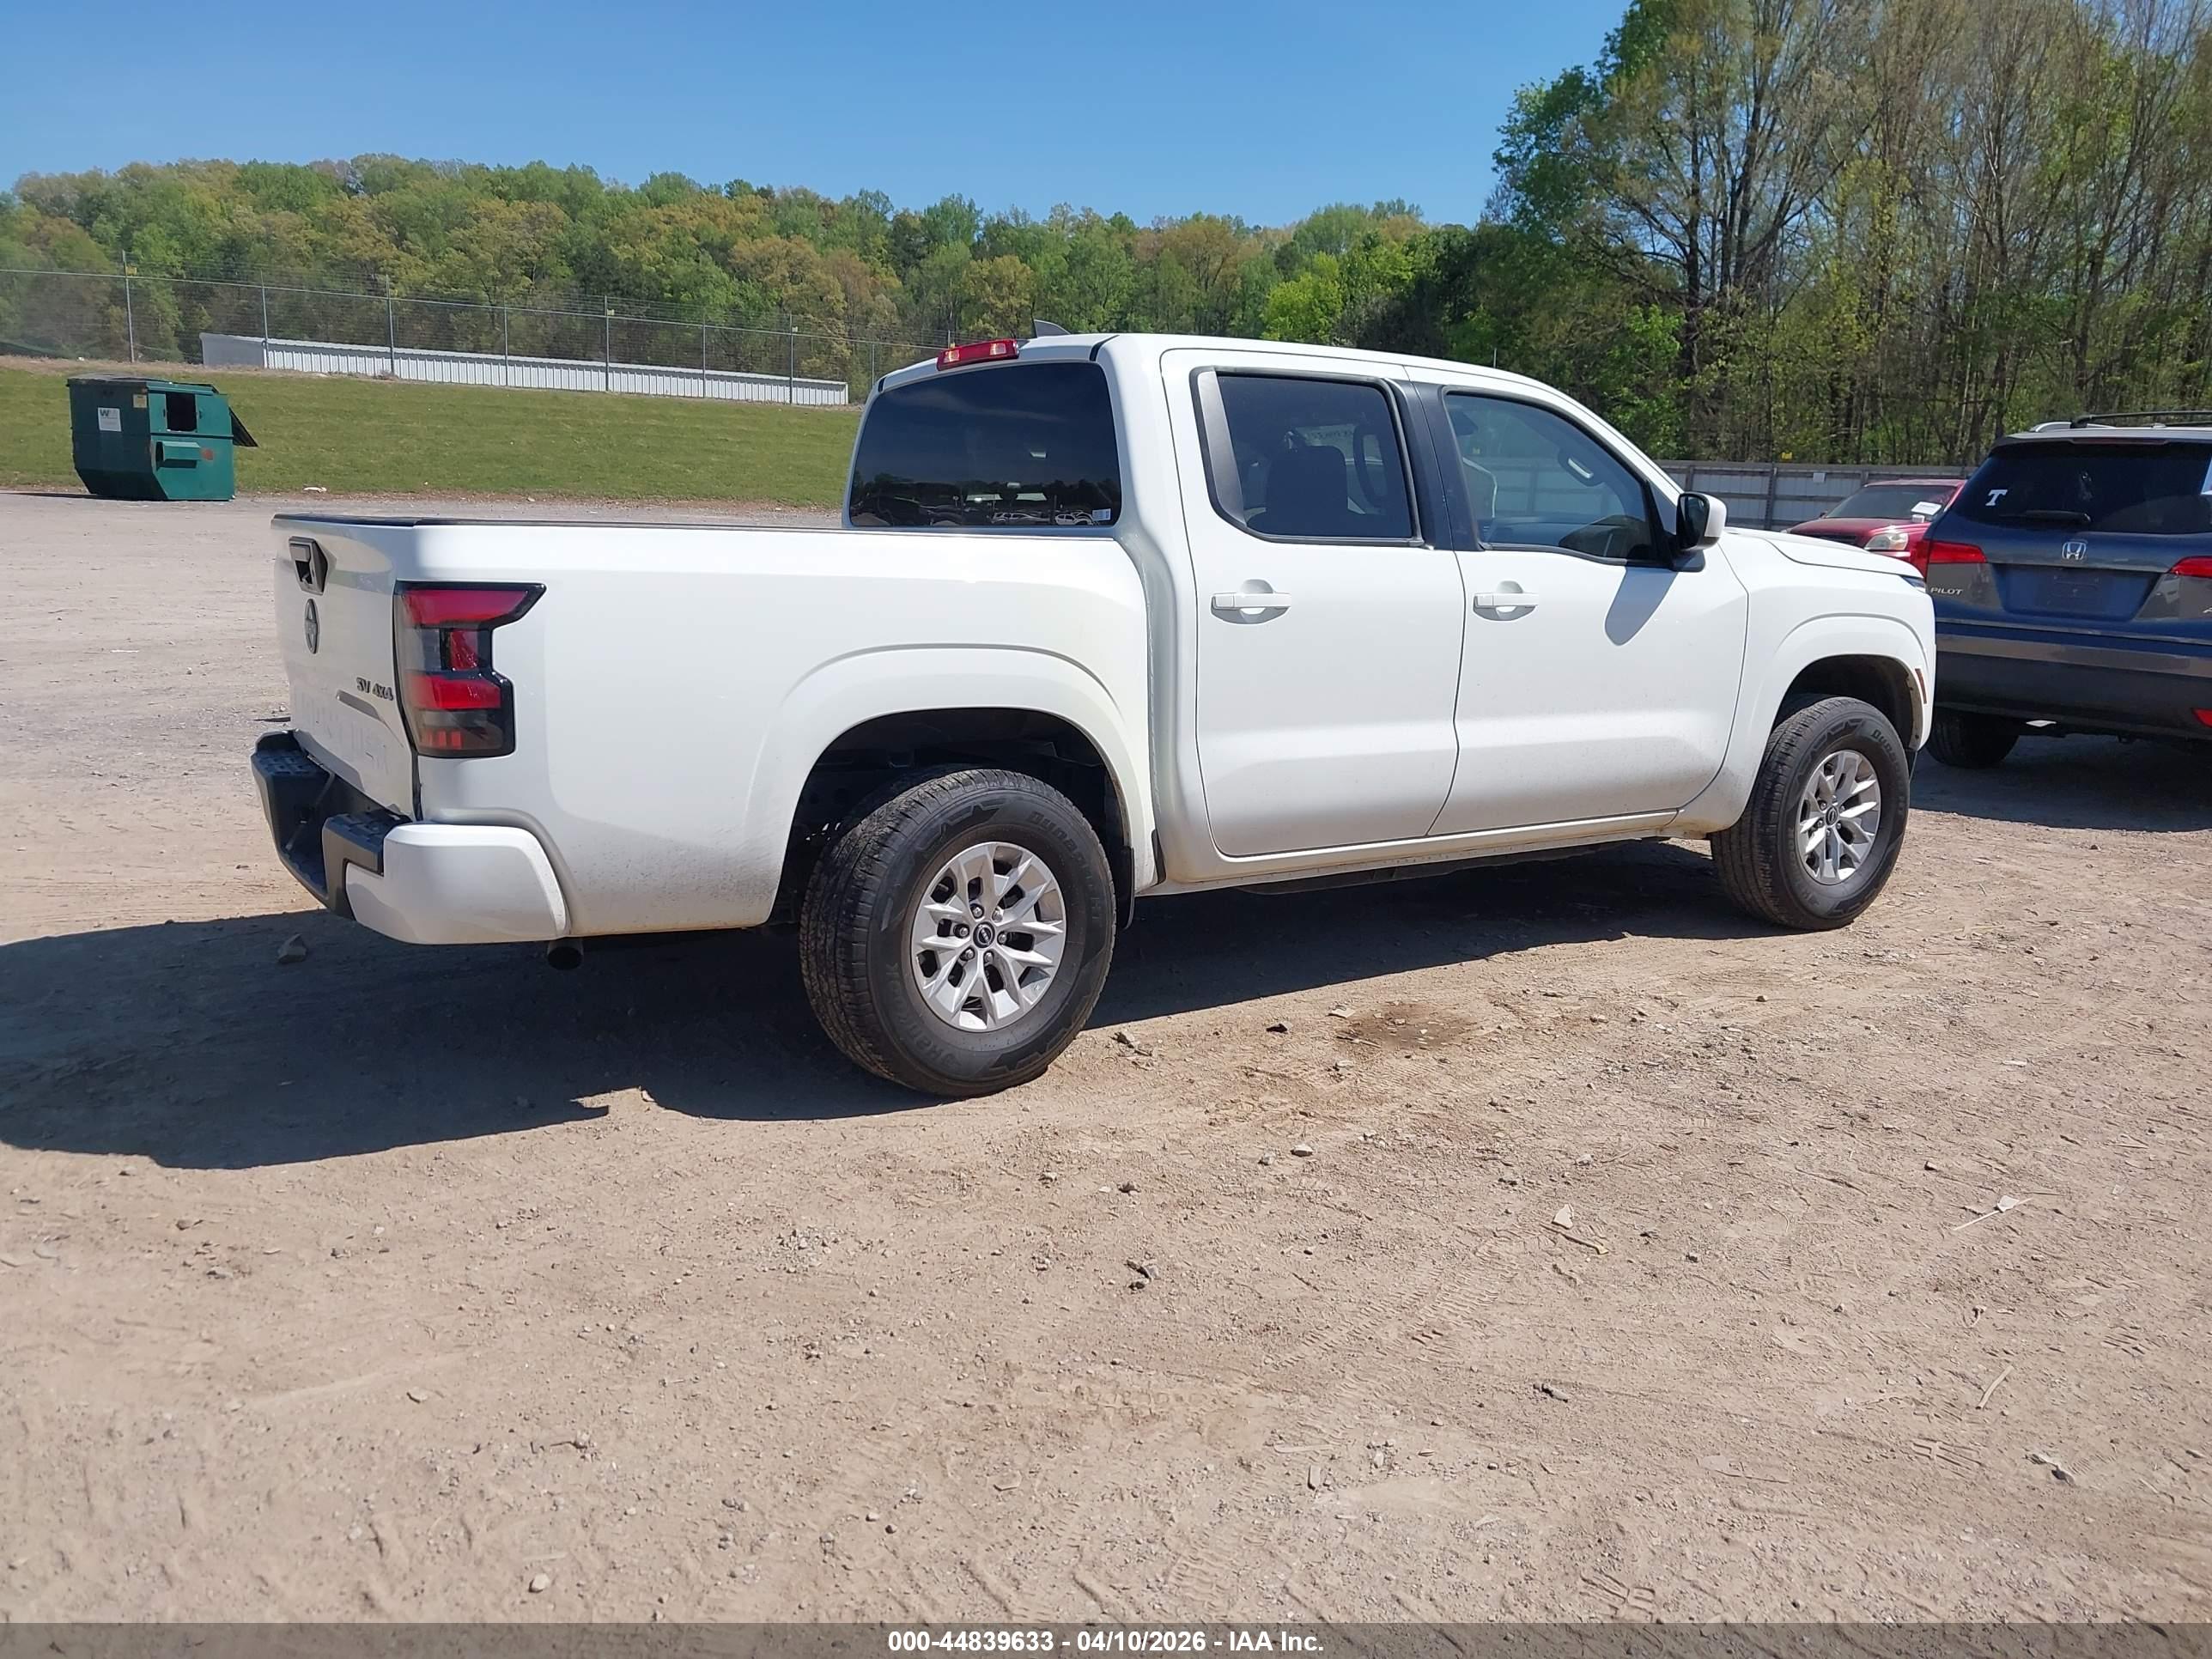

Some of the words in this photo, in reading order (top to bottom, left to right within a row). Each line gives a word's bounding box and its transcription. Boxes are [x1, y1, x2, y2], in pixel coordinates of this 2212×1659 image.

[1985, 489, 2008, 507] T
[1930, 586, 1963, 595] PILOT
[356, 676, 371, 694] SV
